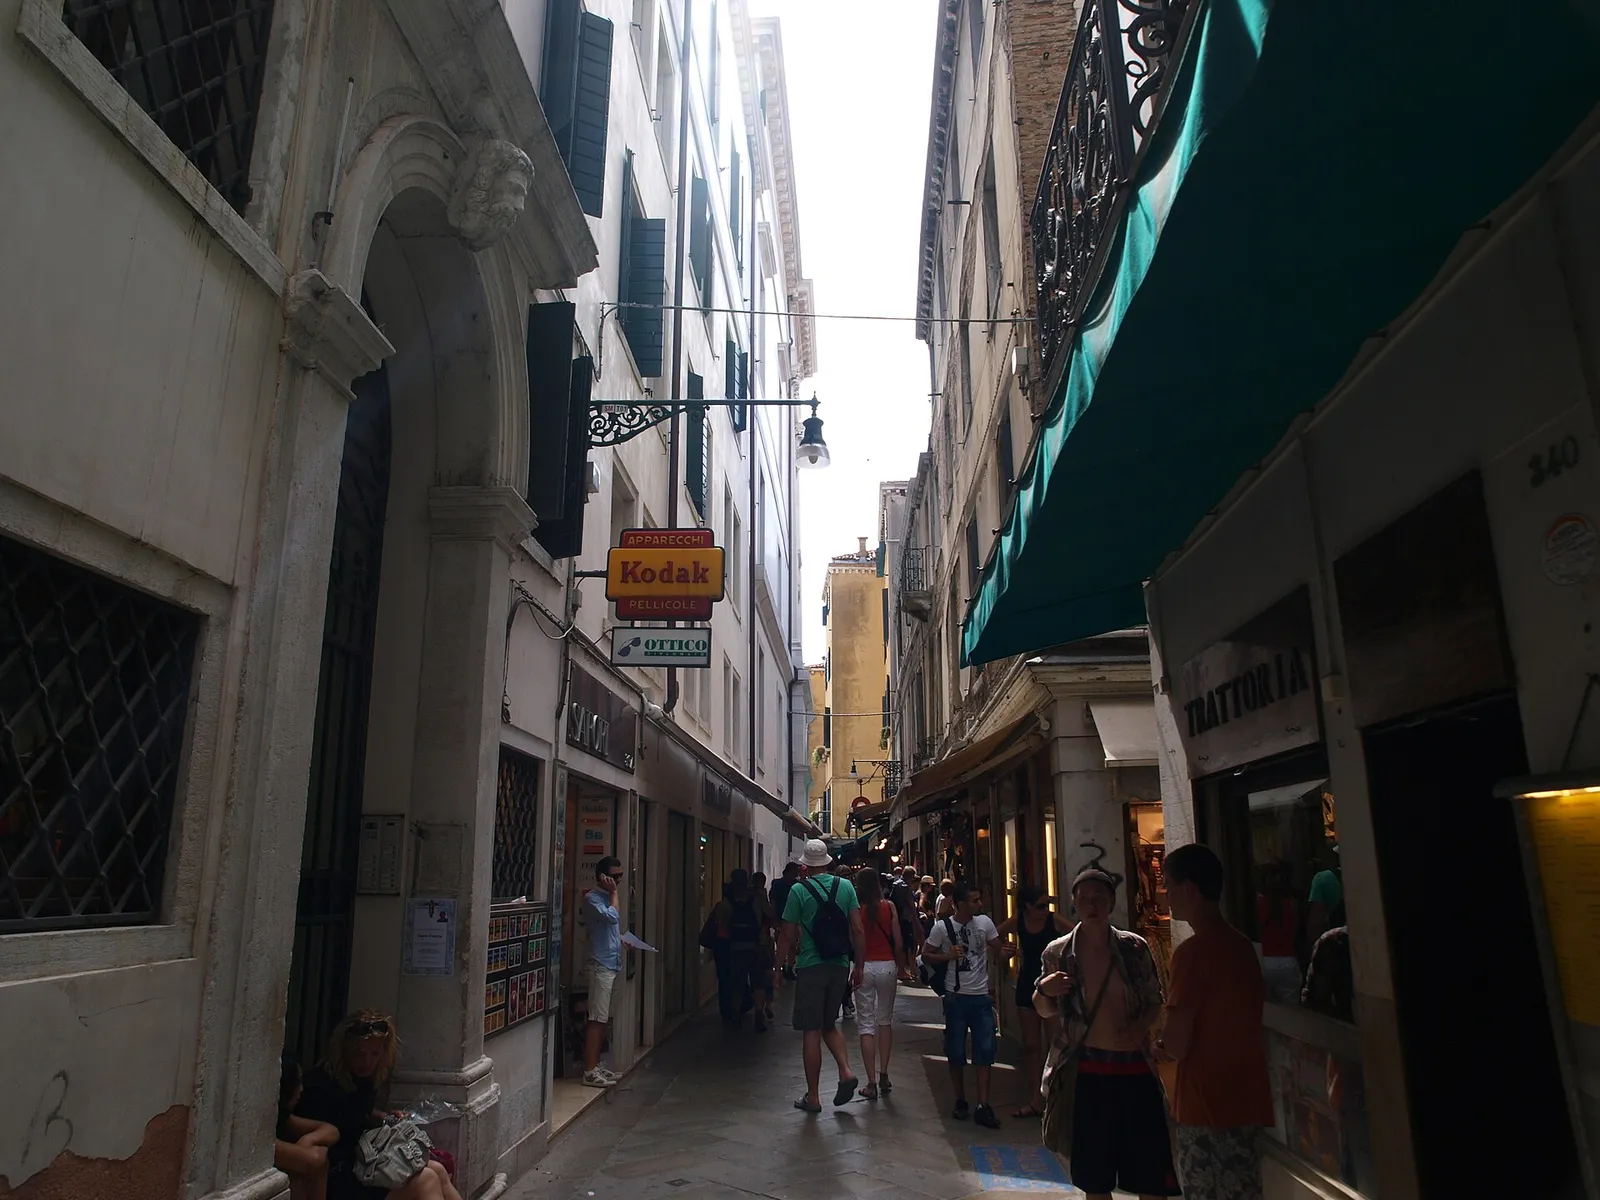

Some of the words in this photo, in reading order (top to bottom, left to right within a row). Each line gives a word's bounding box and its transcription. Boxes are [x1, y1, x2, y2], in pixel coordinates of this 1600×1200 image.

[627, 535, 704, 546] APPARECCHI
[620, 560, 710, 584] Kodak
[629, 600, 697, 610] PELLICOLE
[644, 639, 707, 651] OTTICO
[1184, 646, 1308, 737] TRATTORIA
